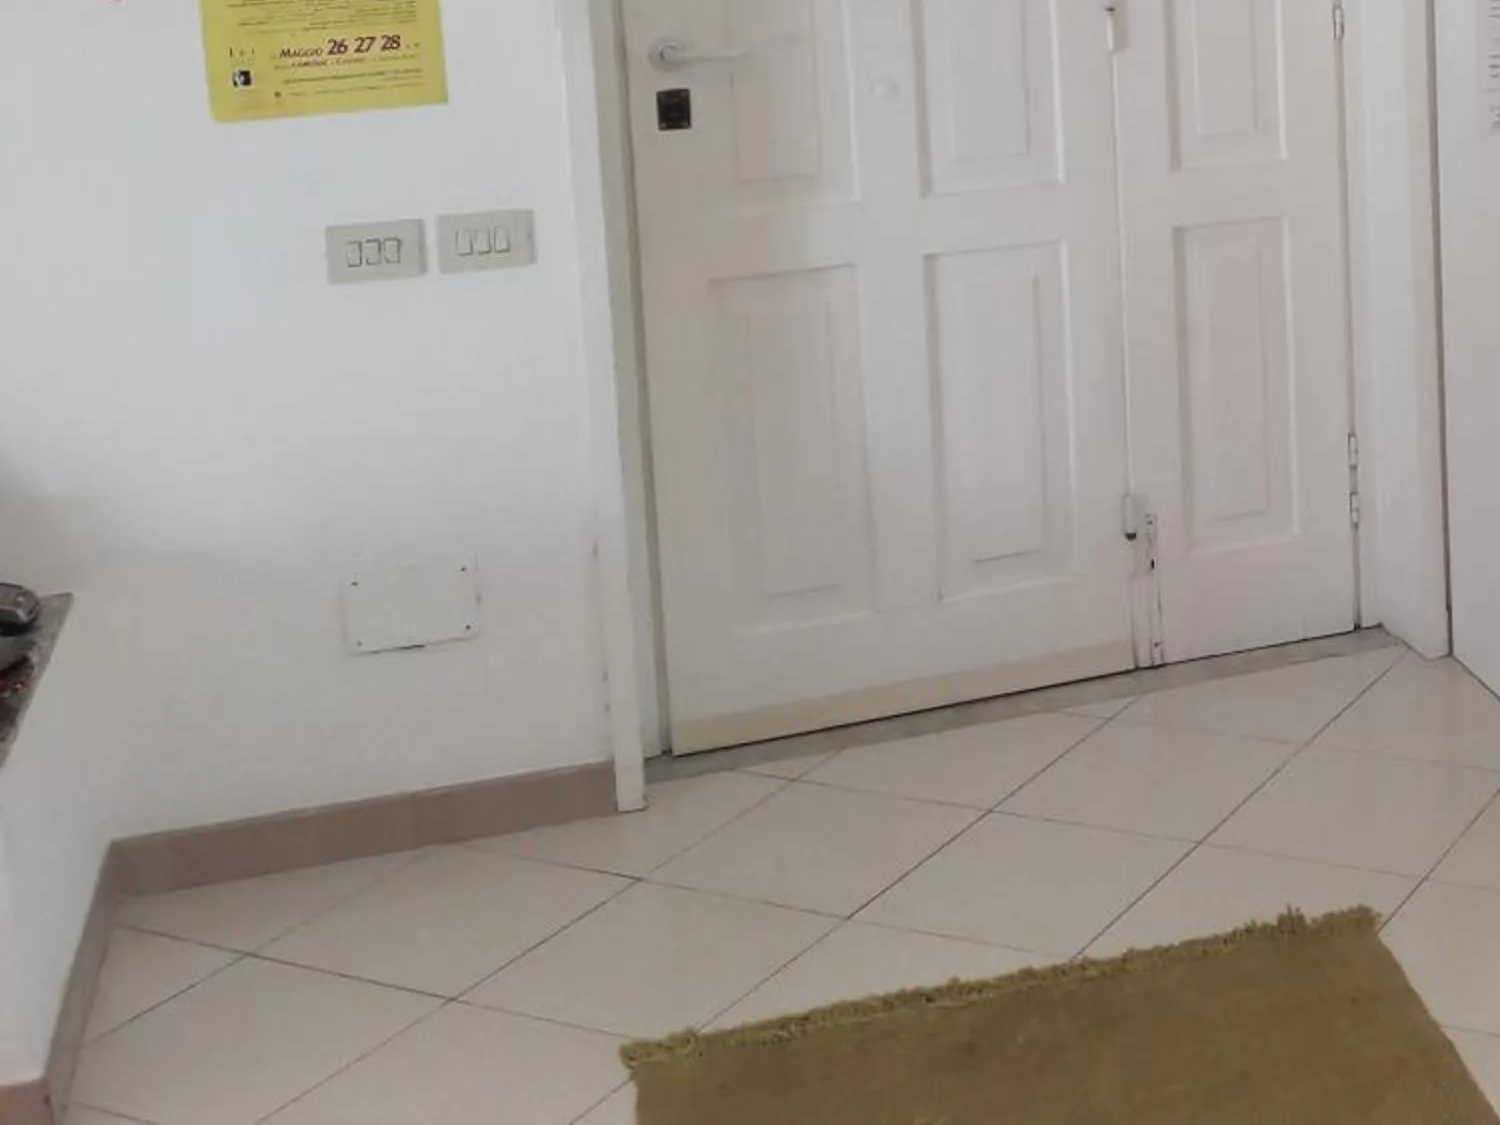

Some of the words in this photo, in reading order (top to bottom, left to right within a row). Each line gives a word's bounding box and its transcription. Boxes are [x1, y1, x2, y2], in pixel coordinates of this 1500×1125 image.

[327, 38, 349, 56] 26
[353, 36, 377, 54] 27
[379, 34, 401, 52] 28
